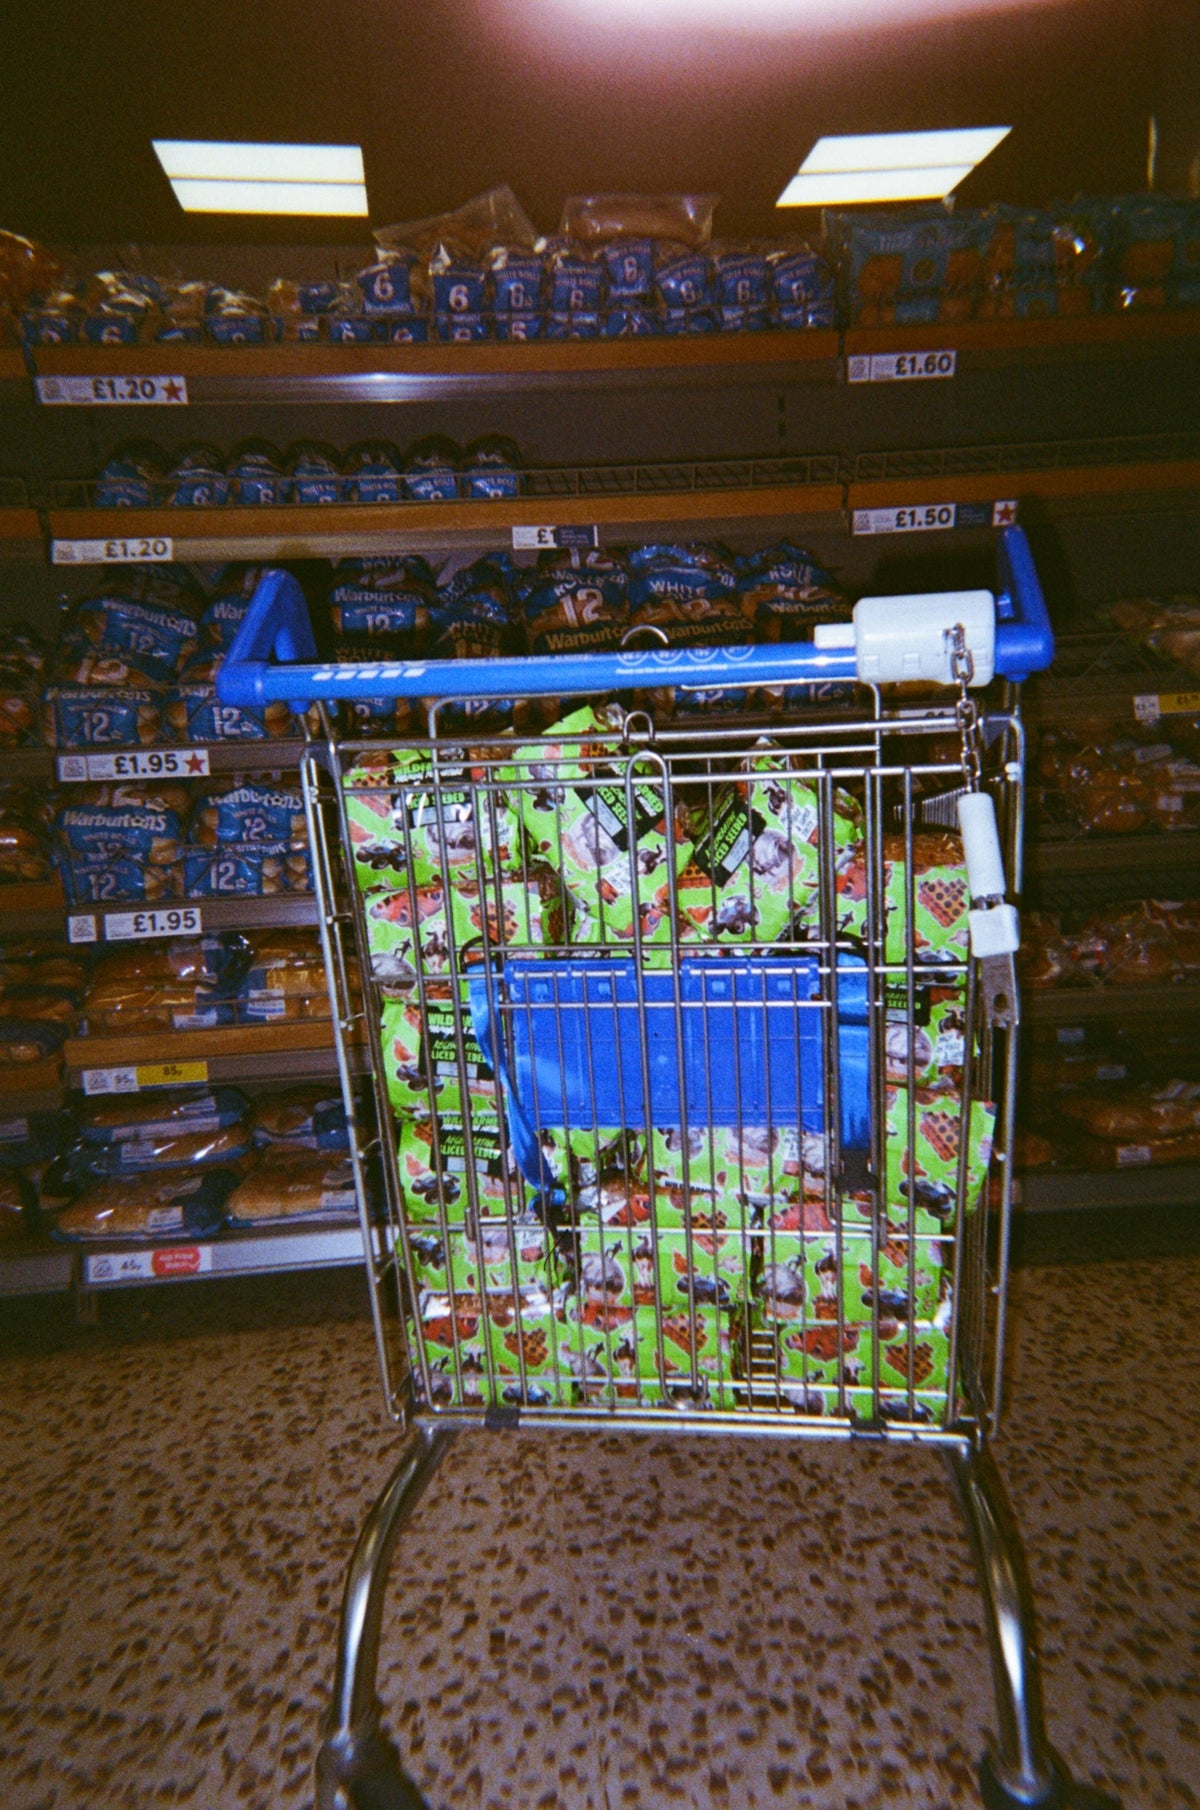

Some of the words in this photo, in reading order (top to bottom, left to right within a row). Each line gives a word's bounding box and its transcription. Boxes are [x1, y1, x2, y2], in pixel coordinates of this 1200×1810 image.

[374, 271, 394, 300] 6
[737, 279, 750, 302] 6
[449, 284, 469, 312] 6
[895, 353, 952, 377] £1.60
[91, 378, 156, 401] £1.20
[193, 486, 210, 505] 6
[895, 507, 952, 528] £1.50
[105, 540, 168, 558] £1.20
[649, 580, 707, 597] WHITE
[560, 588, 614, 628] 12
[768, 602, 853, 615] Warburto
[546, 627, 632, 650] Warburto
[82, 712, 111, 742] 12
[213, 706, 242, 736] 12
[114, 753, 178, 775] £1.95
[208, 788, 303, 810] Warburtons
[64, 810, 168, 831] Warburtons
[243, 817, 267, 841] 12
[725, 812, 748, 844] SEEDED
[89, 874, 117, 901] 12
[210, 862, 236, 891] 12
[133, 910, 196, 933] £1.95
[887, 1000, 921, 1010] SEED
